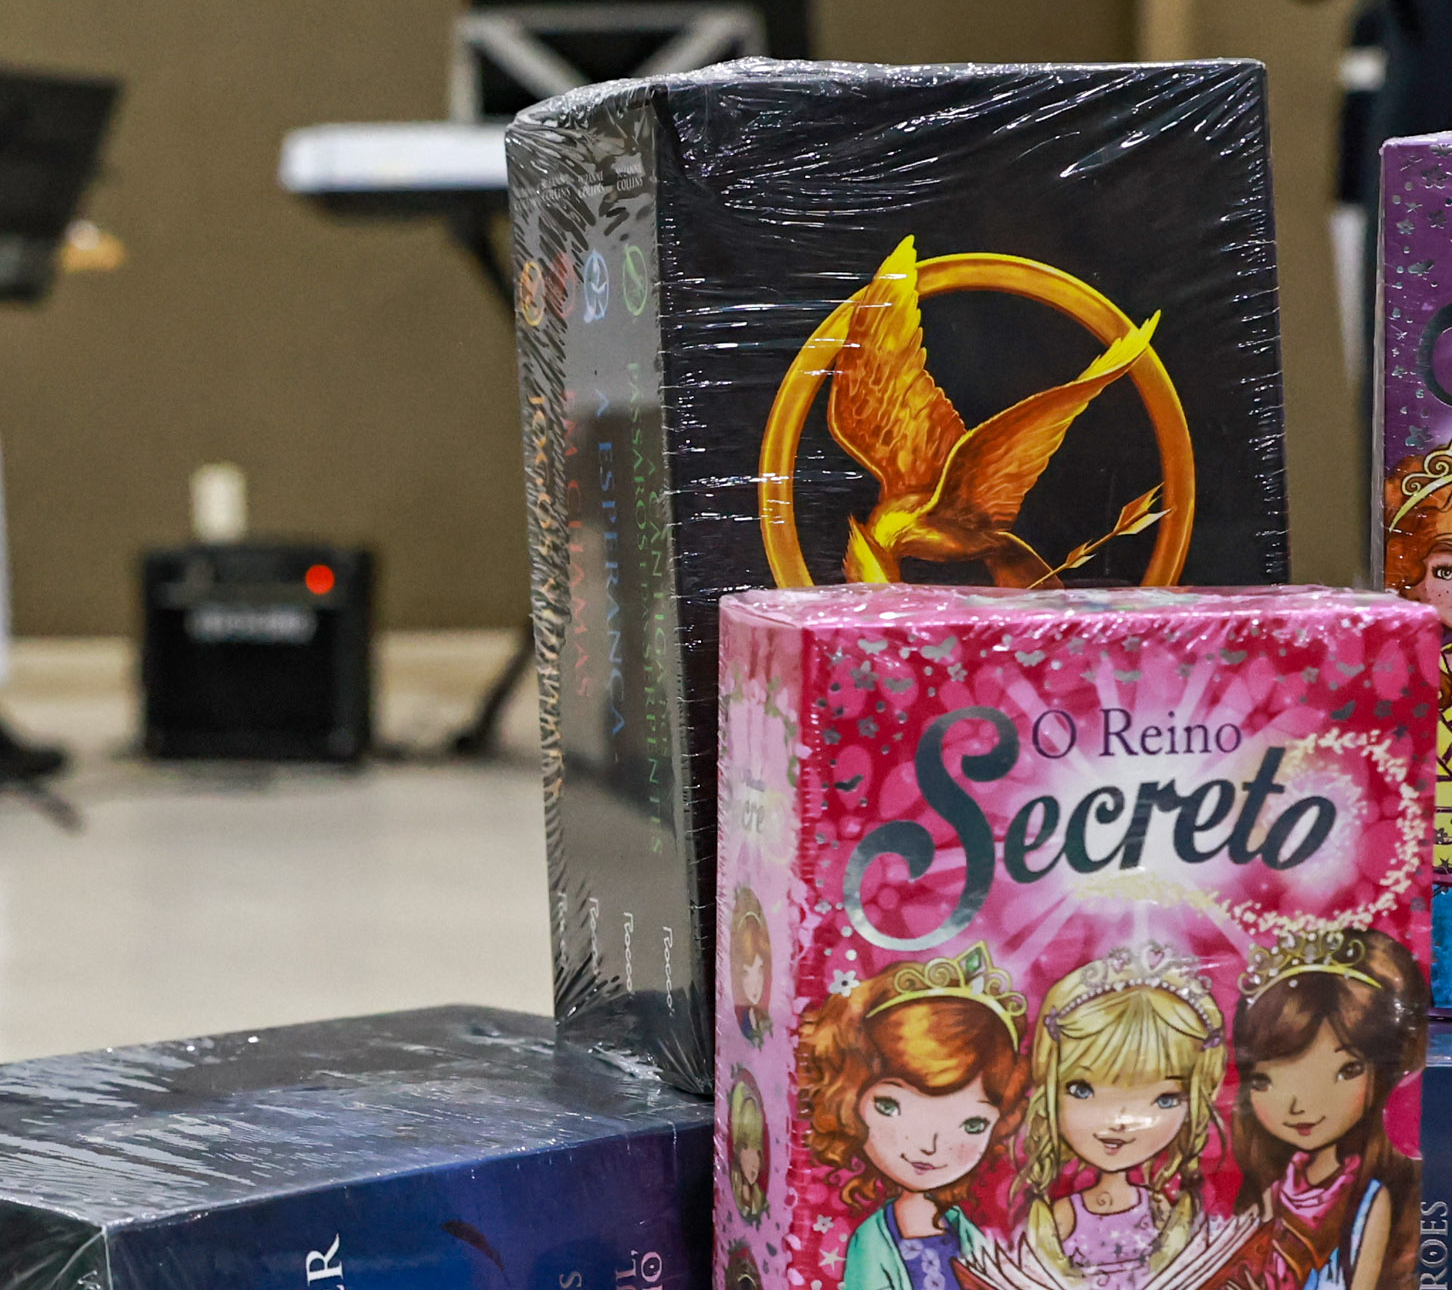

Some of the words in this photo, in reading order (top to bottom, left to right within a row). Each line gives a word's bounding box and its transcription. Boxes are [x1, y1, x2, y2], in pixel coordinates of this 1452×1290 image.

[1031, 711, 1078, 760] O
[1097, 709, 1243, 760] Reino
[844, 705, 1336, 950] Secreto
